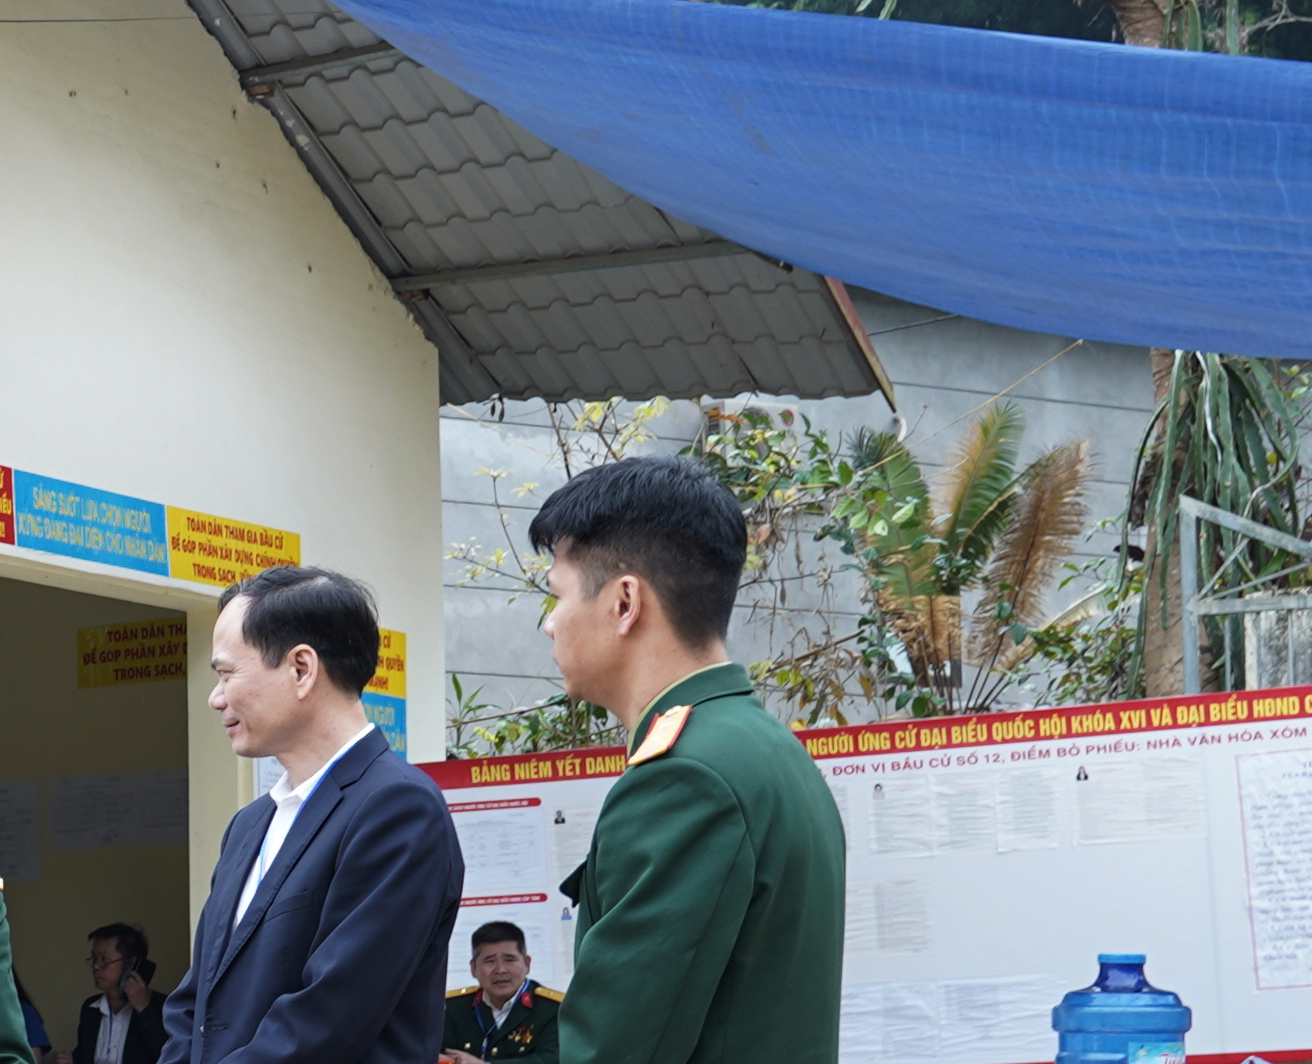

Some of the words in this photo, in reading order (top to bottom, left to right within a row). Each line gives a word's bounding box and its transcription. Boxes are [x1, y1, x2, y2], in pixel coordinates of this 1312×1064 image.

[187, 515, 206, 534] TOÀN
[208, 519, 223, 537] DÂN
[107, 626, 138, 642] TOÀN
[141, 622, 164, 640] DÂN
[82, 647, 97, 666] ĐỂ
[98, 647, 121, 664] GÓP
[124, 643, 156, 660] PHẦN
[158, 640, 179, 658] XÂY
[114, 666, 151, 681] TRONG
[806, 731, 853, 756] NGƯỜI
[858, 730, 890, 752] ỨNG
[894, 724, 916, 748] CỬ
[920, 727, 947, 750] ĐẠI
[951, 718, 988, 744] BIỂU
[992, 714, 1035, 742] QUỐC
[1039, 714, 1067, 739] HỘI
[1071, 709, 1115, 734] KHÓA
[1119, 710, 1146, 730] XVI
[1150, 704, 1173, 728] VÀ
[1176, 704, 1206, 728] ĐẠI
[1209, 694, 1248, 722] BIỂU
[1252, 696, 1300, 718] HĐND
[832, 762, 866, 776] ĐƠN
[871, 762, 886, 774] VỊ
[929, 753, 952, 768] CỬ
[956, 751, 979, 766] SỐ
[1010, 744, 1051, 762] ĐIỂM
[1056, 742, 1080, 758] BỎ
[1146, 736, 1182, 750] NHÀ
[1188, 733, 1222, 746] VĂN
[1228, 730, 1264, 742] HÓA
[1269, 726, 1308, 740] XÓM
[471, 760, 510, 783] BẢNG
[514, 758, 552, 781] NIÊM
[555, 753, 582, 776] YẾT
[585, 754, 626, 775] DANH
